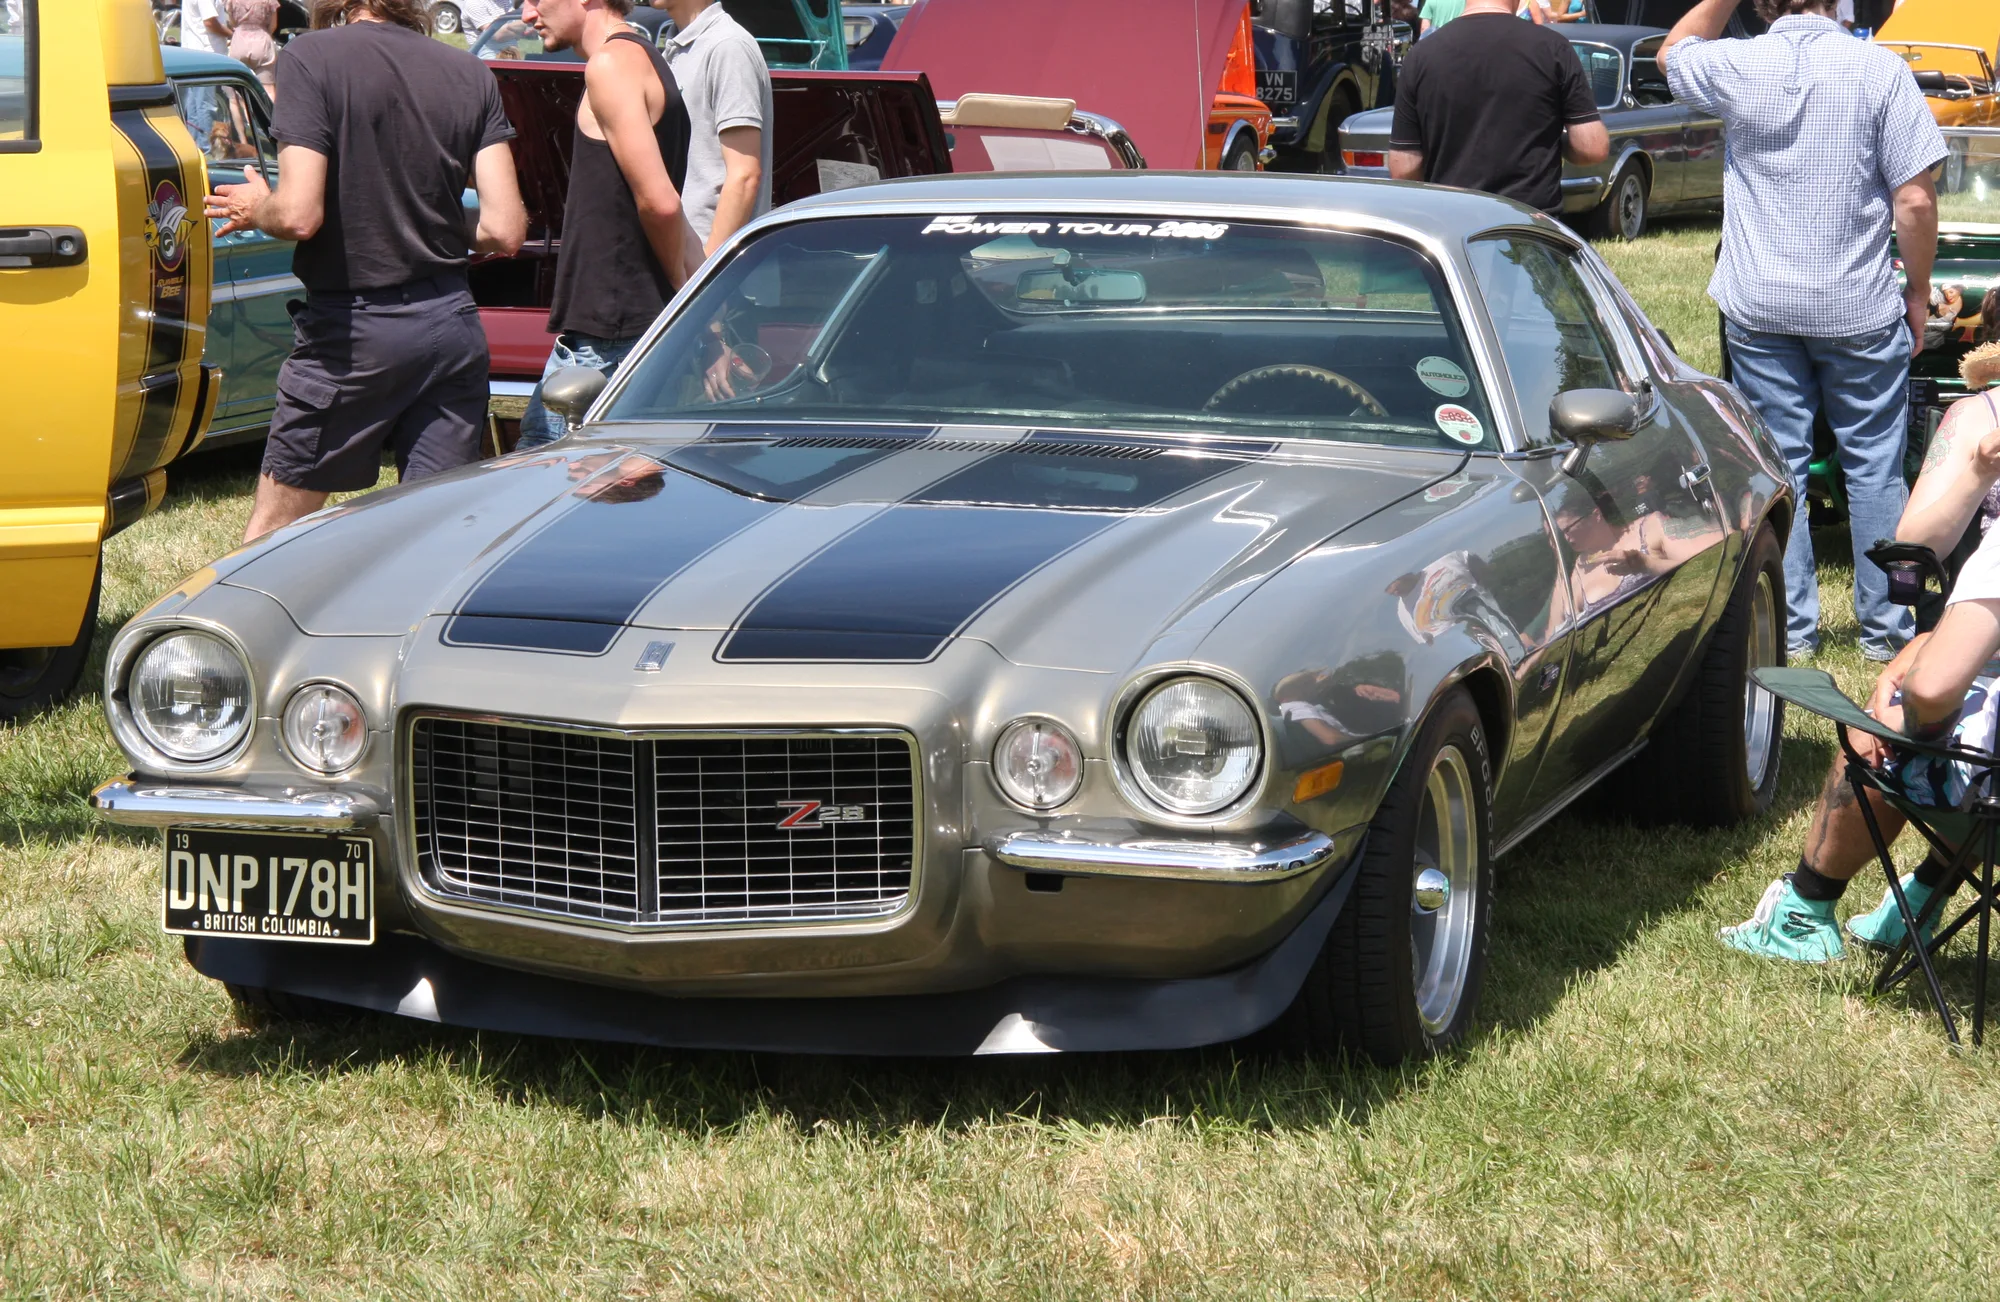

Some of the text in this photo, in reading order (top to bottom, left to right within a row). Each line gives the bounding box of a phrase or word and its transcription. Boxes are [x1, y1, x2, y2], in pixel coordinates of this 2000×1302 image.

[1265, 72, 1284, 86] VN
[1256, 87, 1293, 101] 8275
[921, 222, 1051, 234] POWER
[1057, 223, 1152, 235] TOUR
[160, 286, 181, 298] BEE
[777, 800, 864, 829] Z28
[175, 833, 362, 859] 19 70
[169, 850, 366, 920] DNP 178H
[204, 913, 332, 937] BRITISH COLUMBIA
